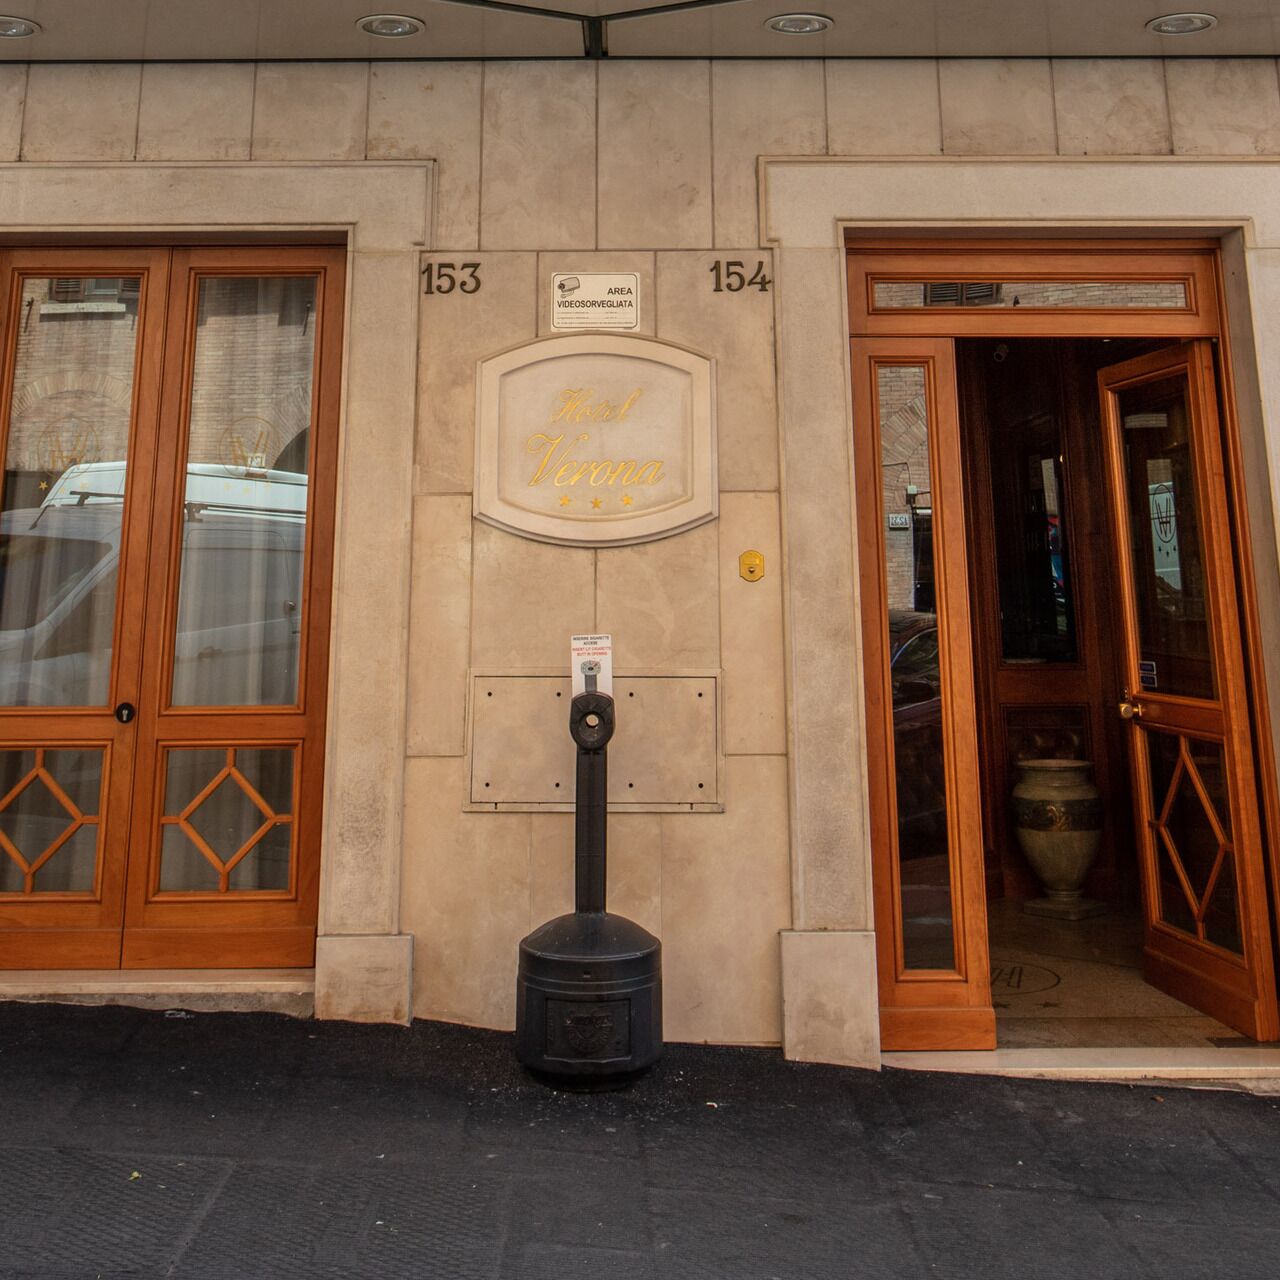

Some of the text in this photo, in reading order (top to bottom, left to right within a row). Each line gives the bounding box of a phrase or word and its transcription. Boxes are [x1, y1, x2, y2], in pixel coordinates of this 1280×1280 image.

[422, 263, 482, 294] 153
[607, 287, 633, 296] AREA
[709, 261, 772, 292] 154
[557, 300, 633, 309] VIDEOSORVEGLIATA
[551, 388, 642, 424] Hotel
[527, 432, 666, 488] Verona
